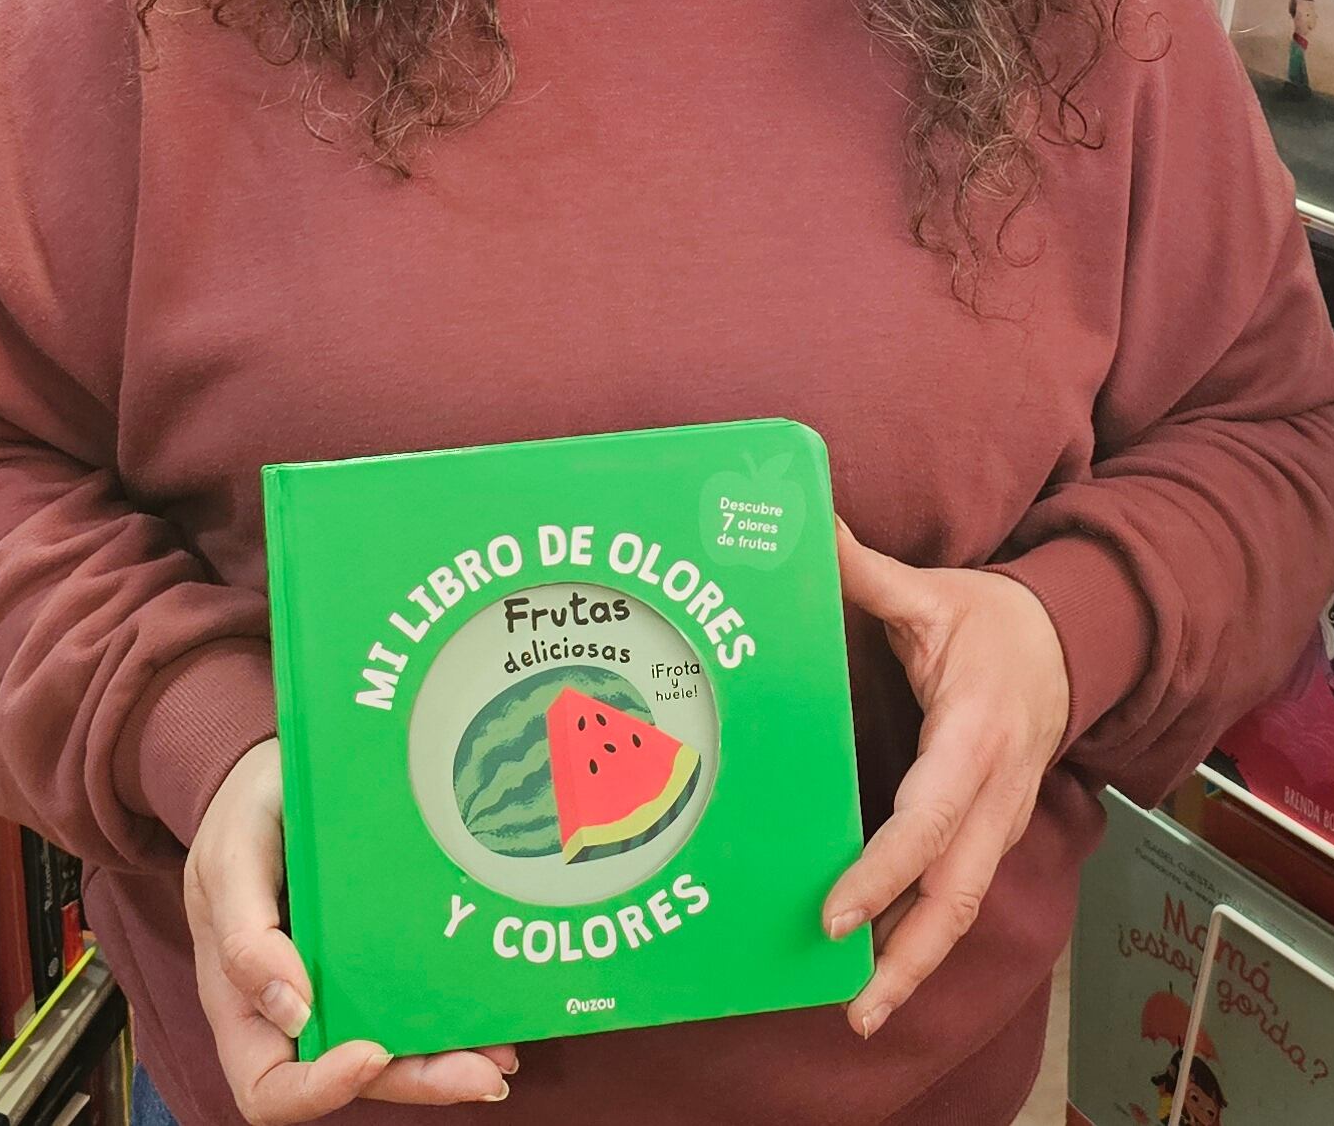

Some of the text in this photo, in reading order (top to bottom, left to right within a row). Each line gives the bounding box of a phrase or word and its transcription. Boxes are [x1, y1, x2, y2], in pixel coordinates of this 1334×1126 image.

[719, 495, 785, 519] Descubre
[721, 512, 780, 536] 7 olores
[716, 531, 779, 554] de frutas
[354, 523, 758, 712] MI LIBRO DE OLORES
[502, 590, 633, 635] Frutas
[502, 636, 633, 675] deliciosas
[650, 659, 704, 680] ¡Frota
[654, 684, 700, 703] huele!
[670, 677, 681, 689] y
[1282, 784, 1321, 824] BRENDA
[441, 872, 712, 965] Y COLORES
[565, 995, 618, 1016] AUZOU
[1214, 977, 1331, 1087] gorda?
